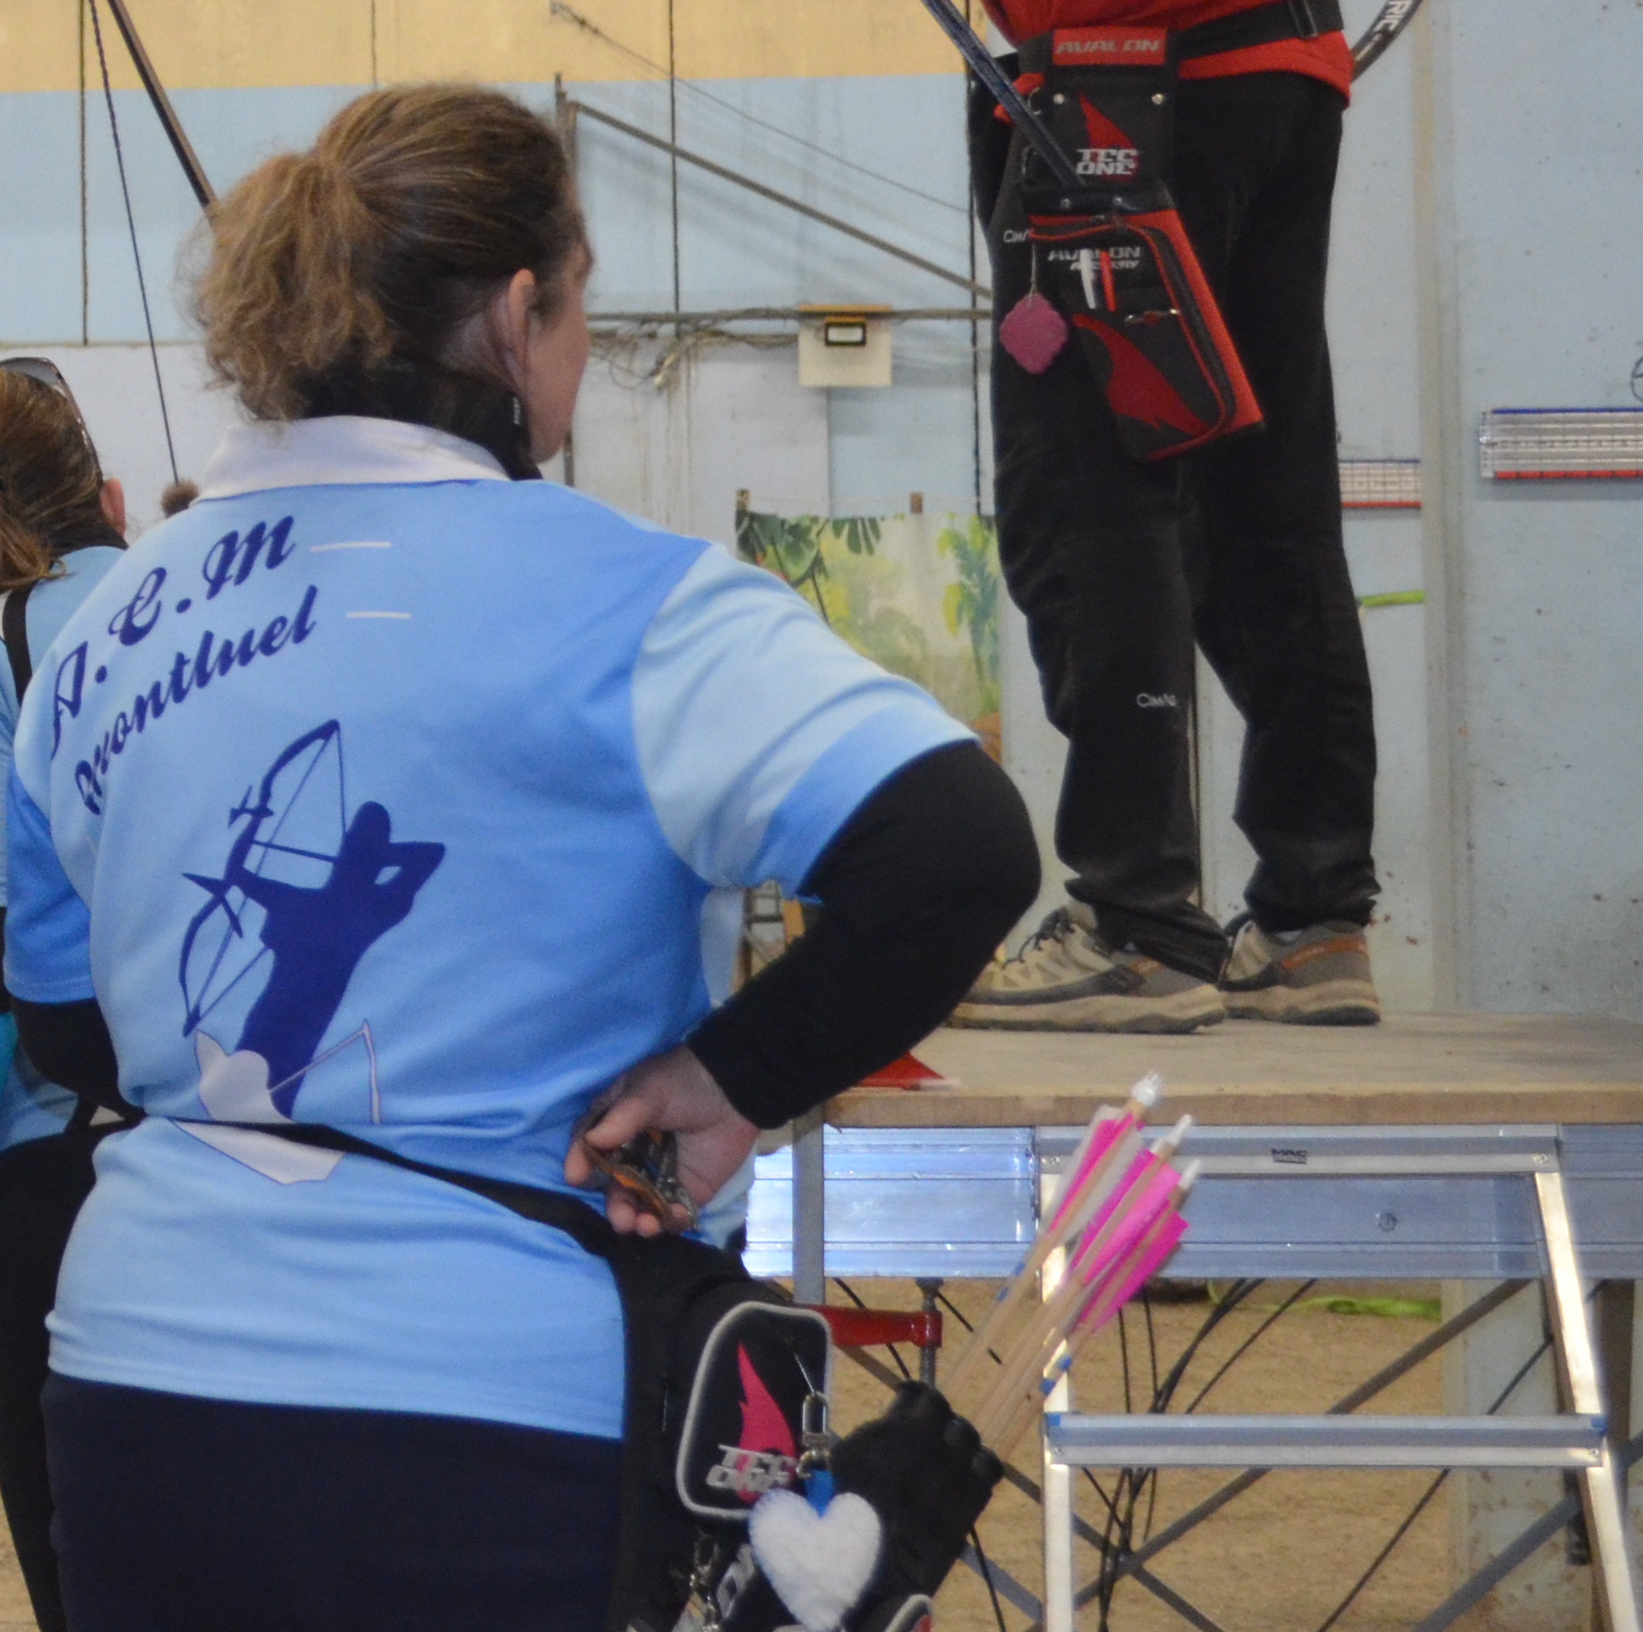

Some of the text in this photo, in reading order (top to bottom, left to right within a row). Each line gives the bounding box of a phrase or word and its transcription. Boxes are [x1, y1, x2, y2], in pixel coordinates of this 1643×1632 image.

[1056, 39, 1160, 54] AVALON
[1075, 161, 1136, 175] ONE
[1048, 246, 1141, 261] AVLON
